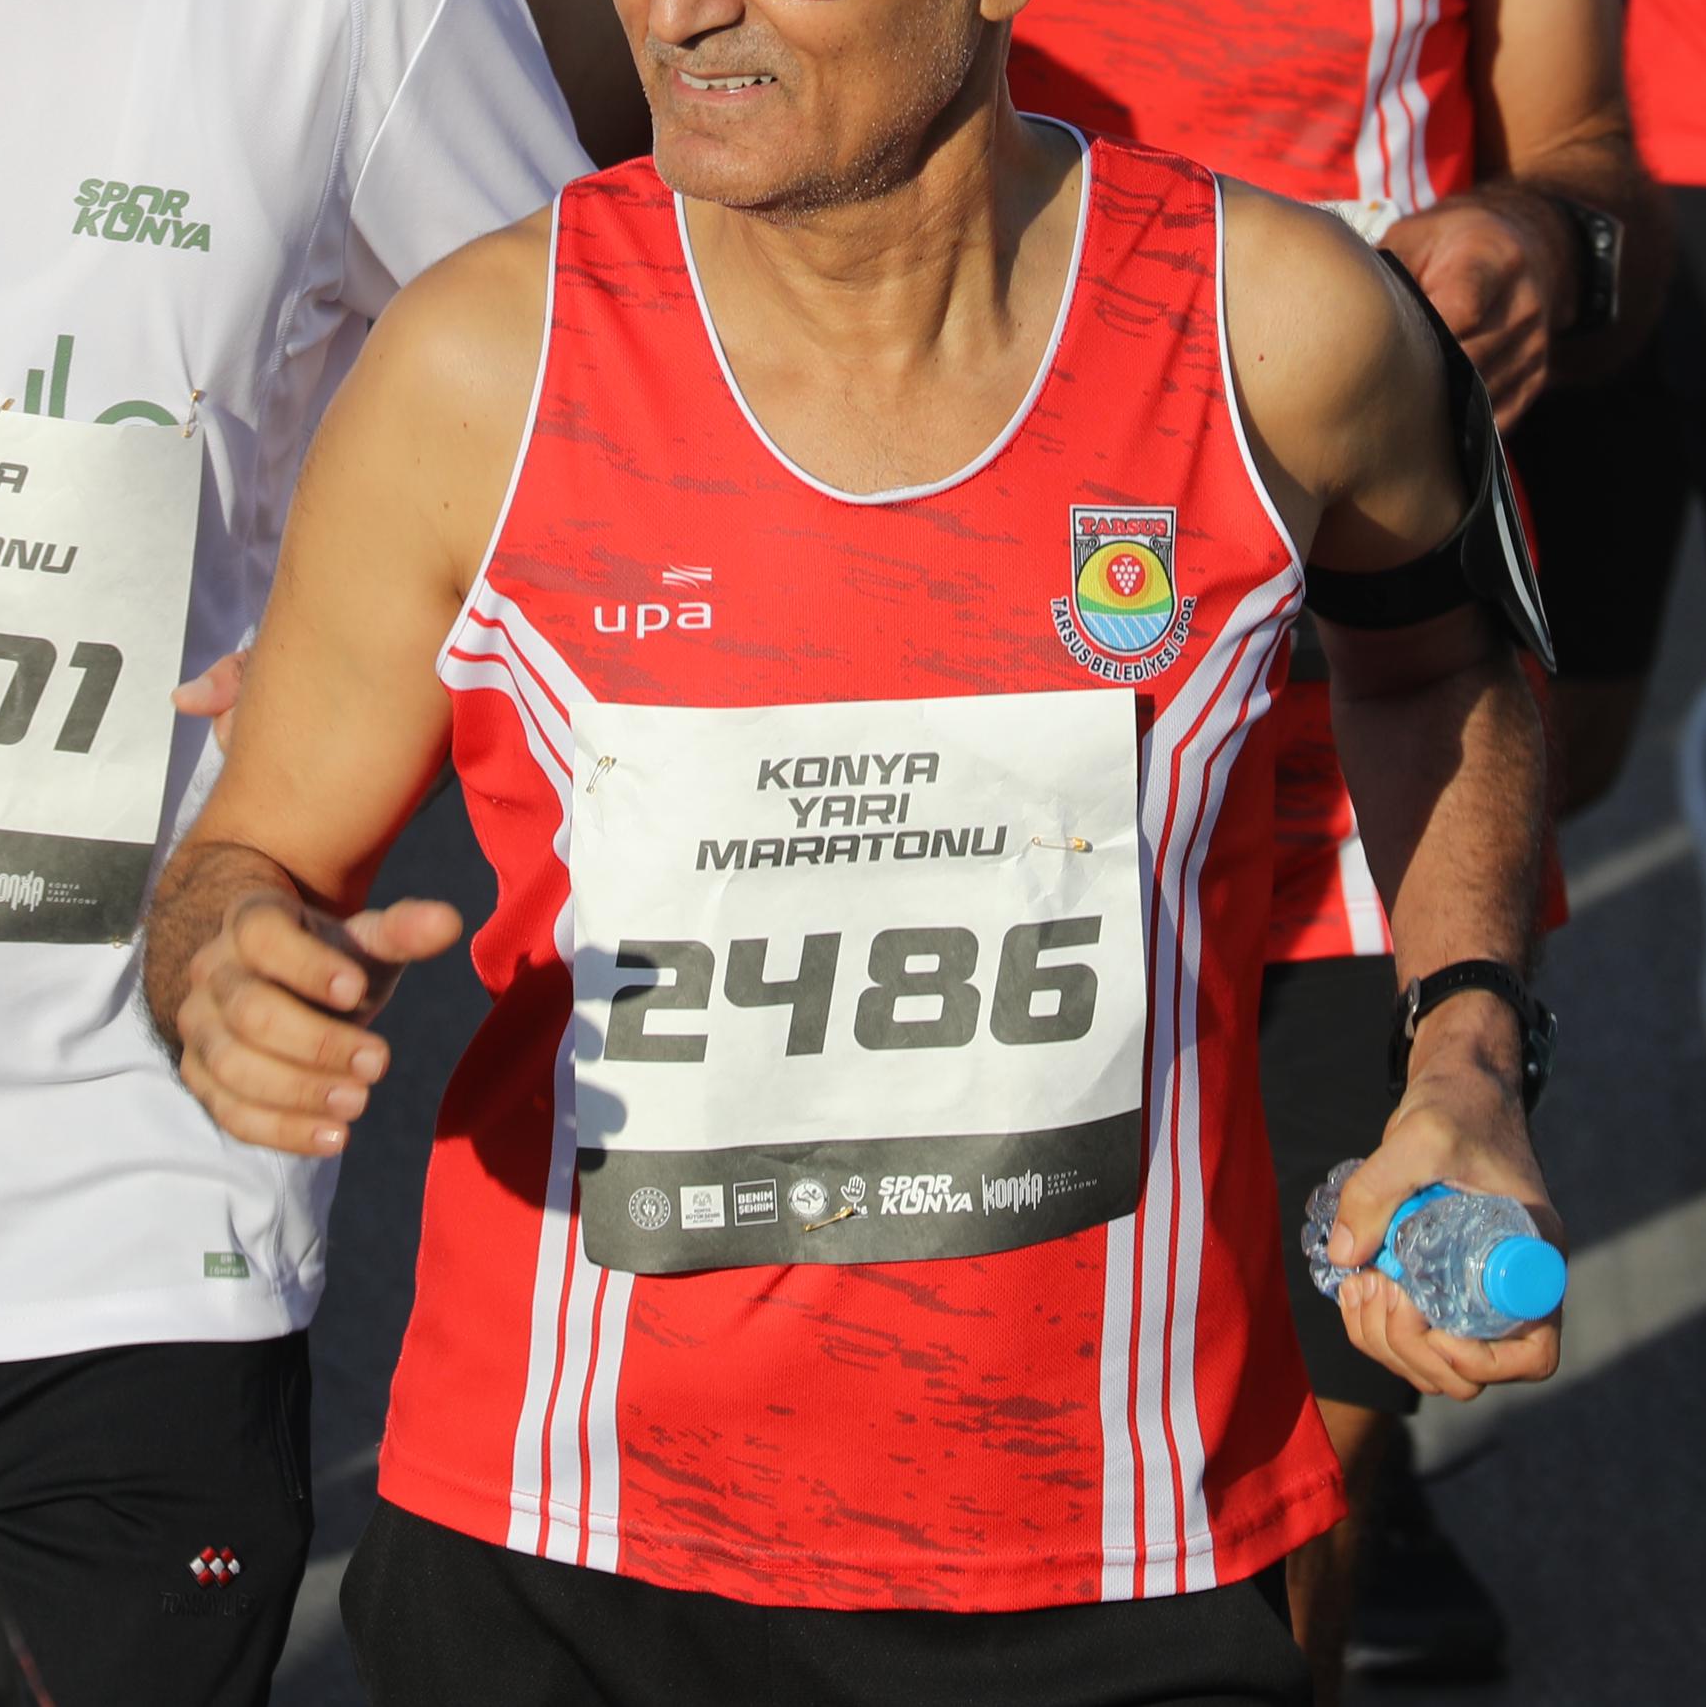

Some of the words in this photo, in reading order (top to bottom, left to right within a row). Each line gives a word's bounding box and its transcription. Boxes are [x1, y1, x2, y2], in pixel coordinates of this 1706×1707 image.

[73, 178, 190, 219] SPOR
[72, 200, 211, 252] KONYA
[1079, 517, 1168, 537] TARSUS
[594, 601, 712, 639] upa
[1052, 597, 1091, 663] TARSUS
[1173, 597, 1195, 644] SPOR
[756, 752, 940, 791] KONYA
[789, 794, 909, 829] YARI
[695, 825, 1008, 870] MARATONU
[603, 915, 1104, 1063] 2486
[878, 1174, 953, 1197] SPOR
[1047, 1170, 1078, 1182] KONYA
[880, 1188, 974, 1215] KONYA
